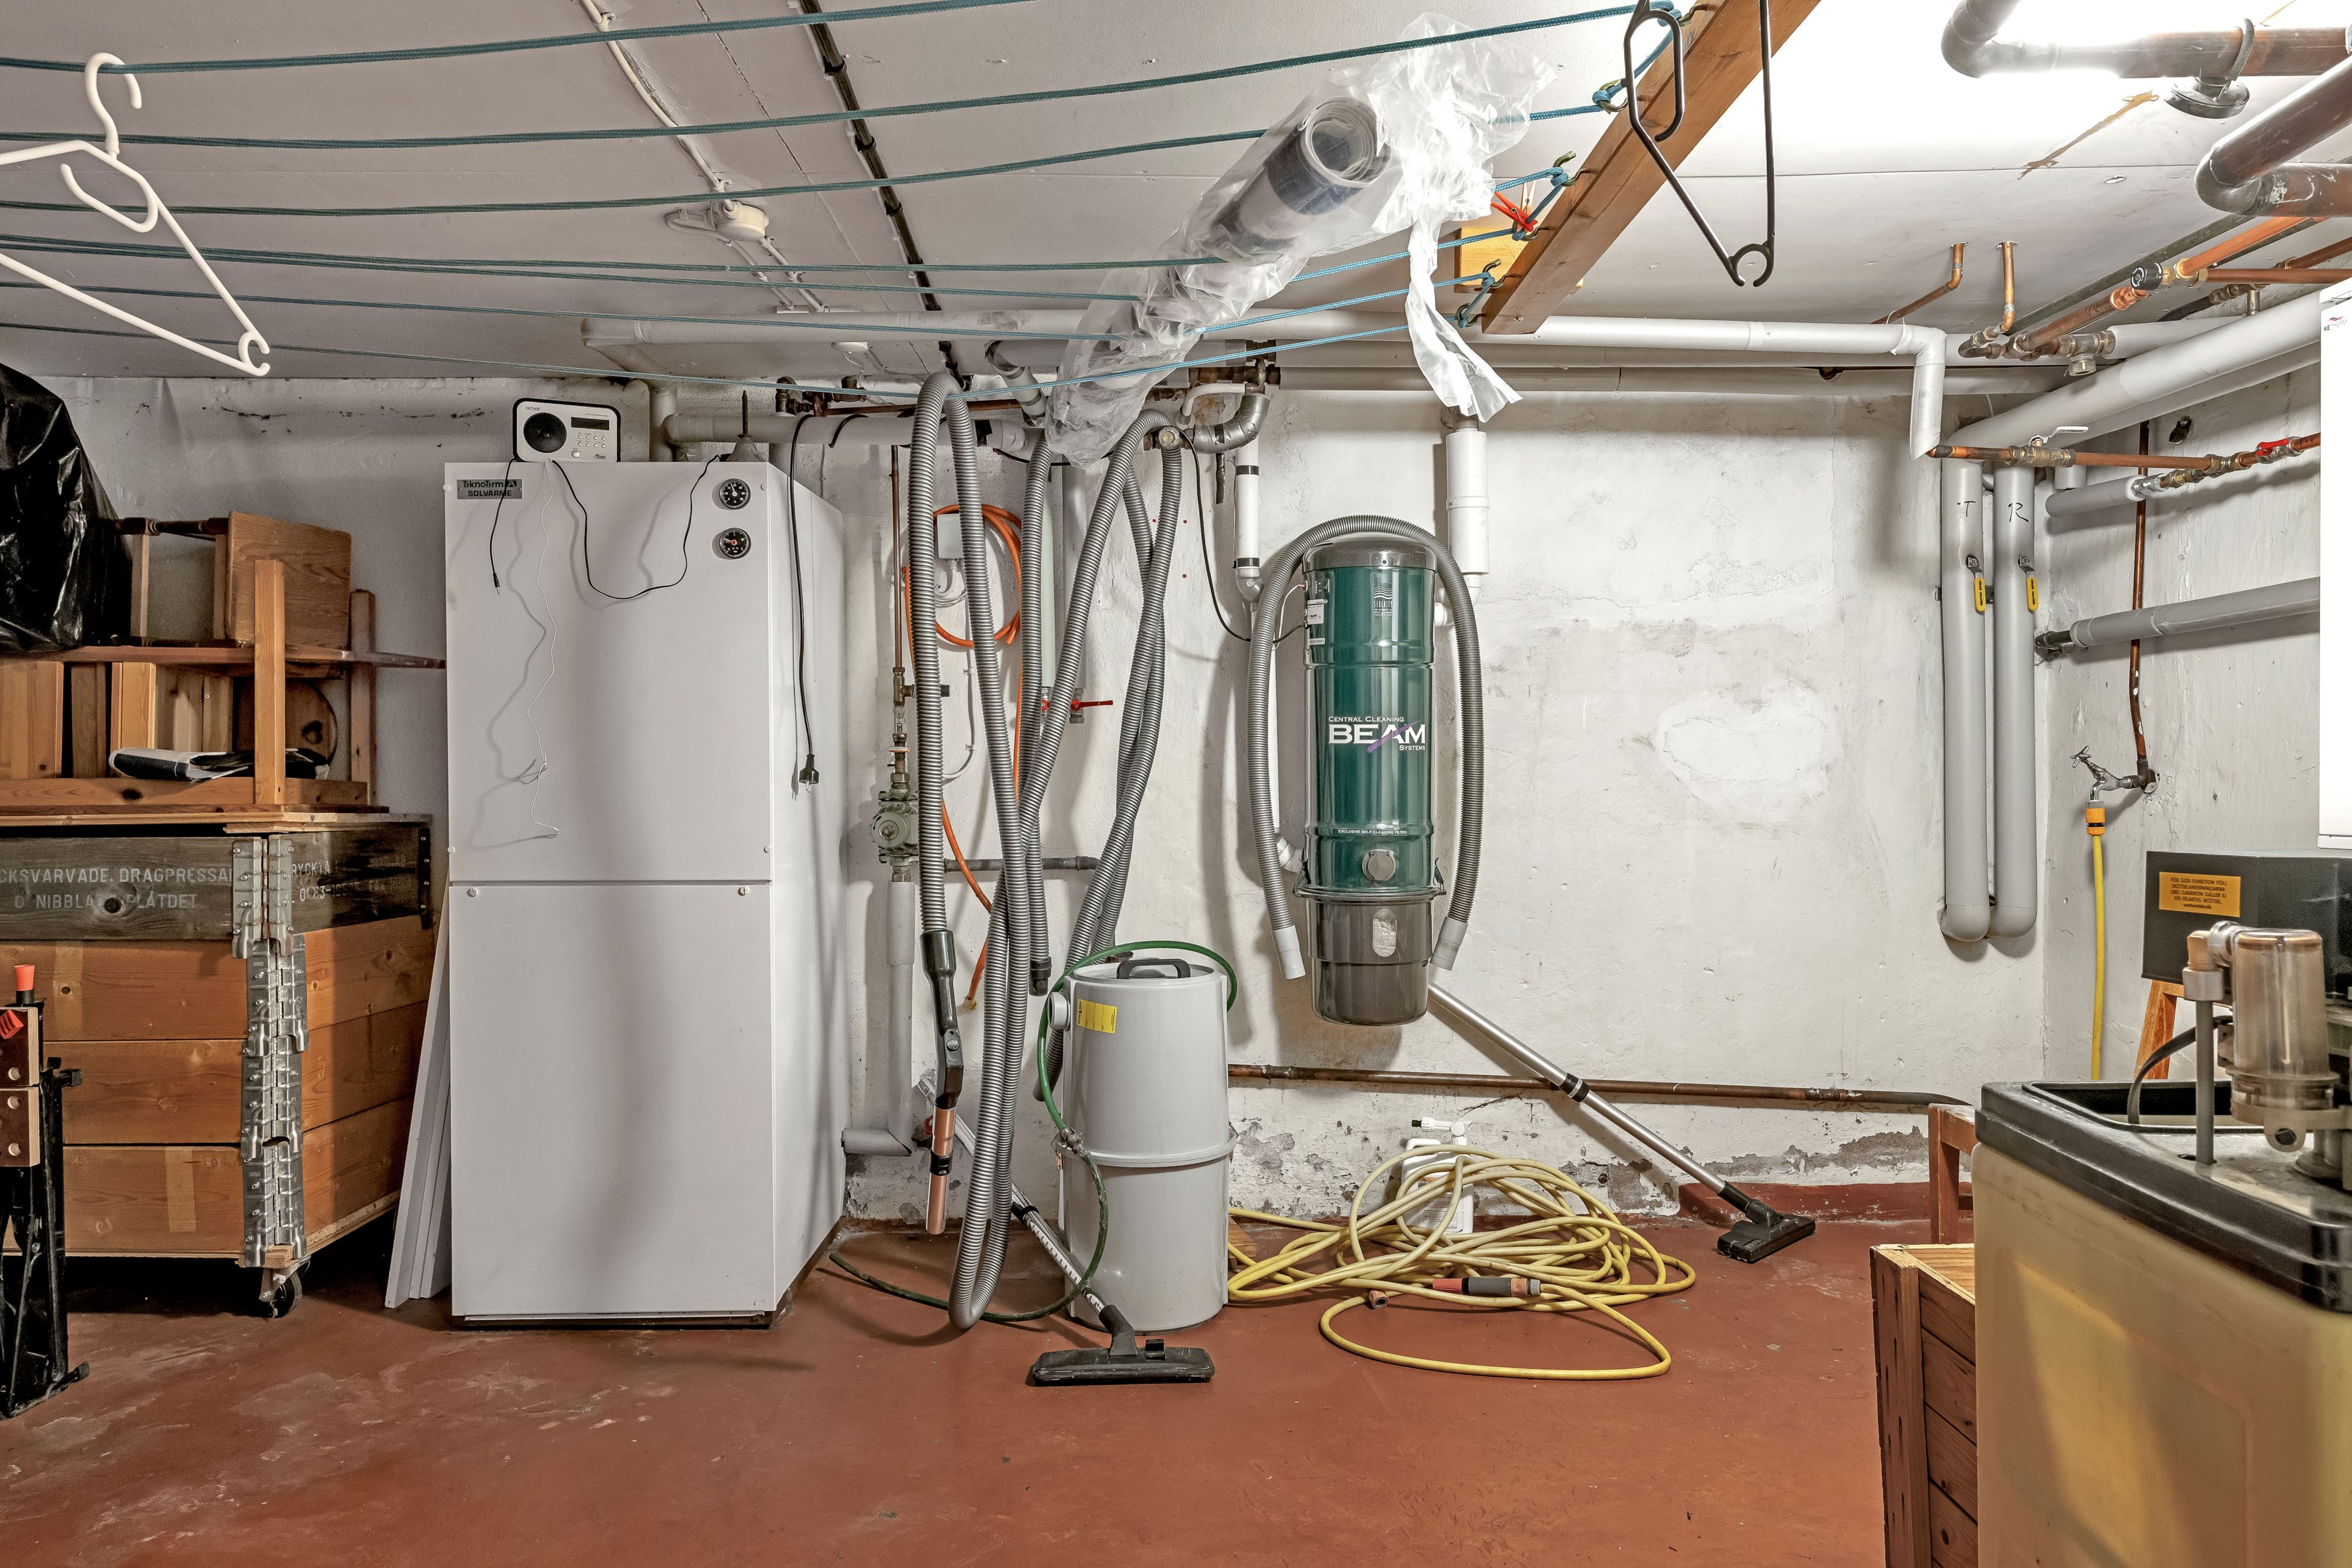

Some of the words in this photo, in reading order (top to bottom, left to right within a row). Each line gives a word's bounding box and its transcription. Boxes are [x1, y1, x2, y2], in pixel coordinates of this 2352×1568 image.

[1957, 500, 1976, 517] T
[2008, 502, 2029, 522] R
[1328, 724, 1426, 744] BEAM
